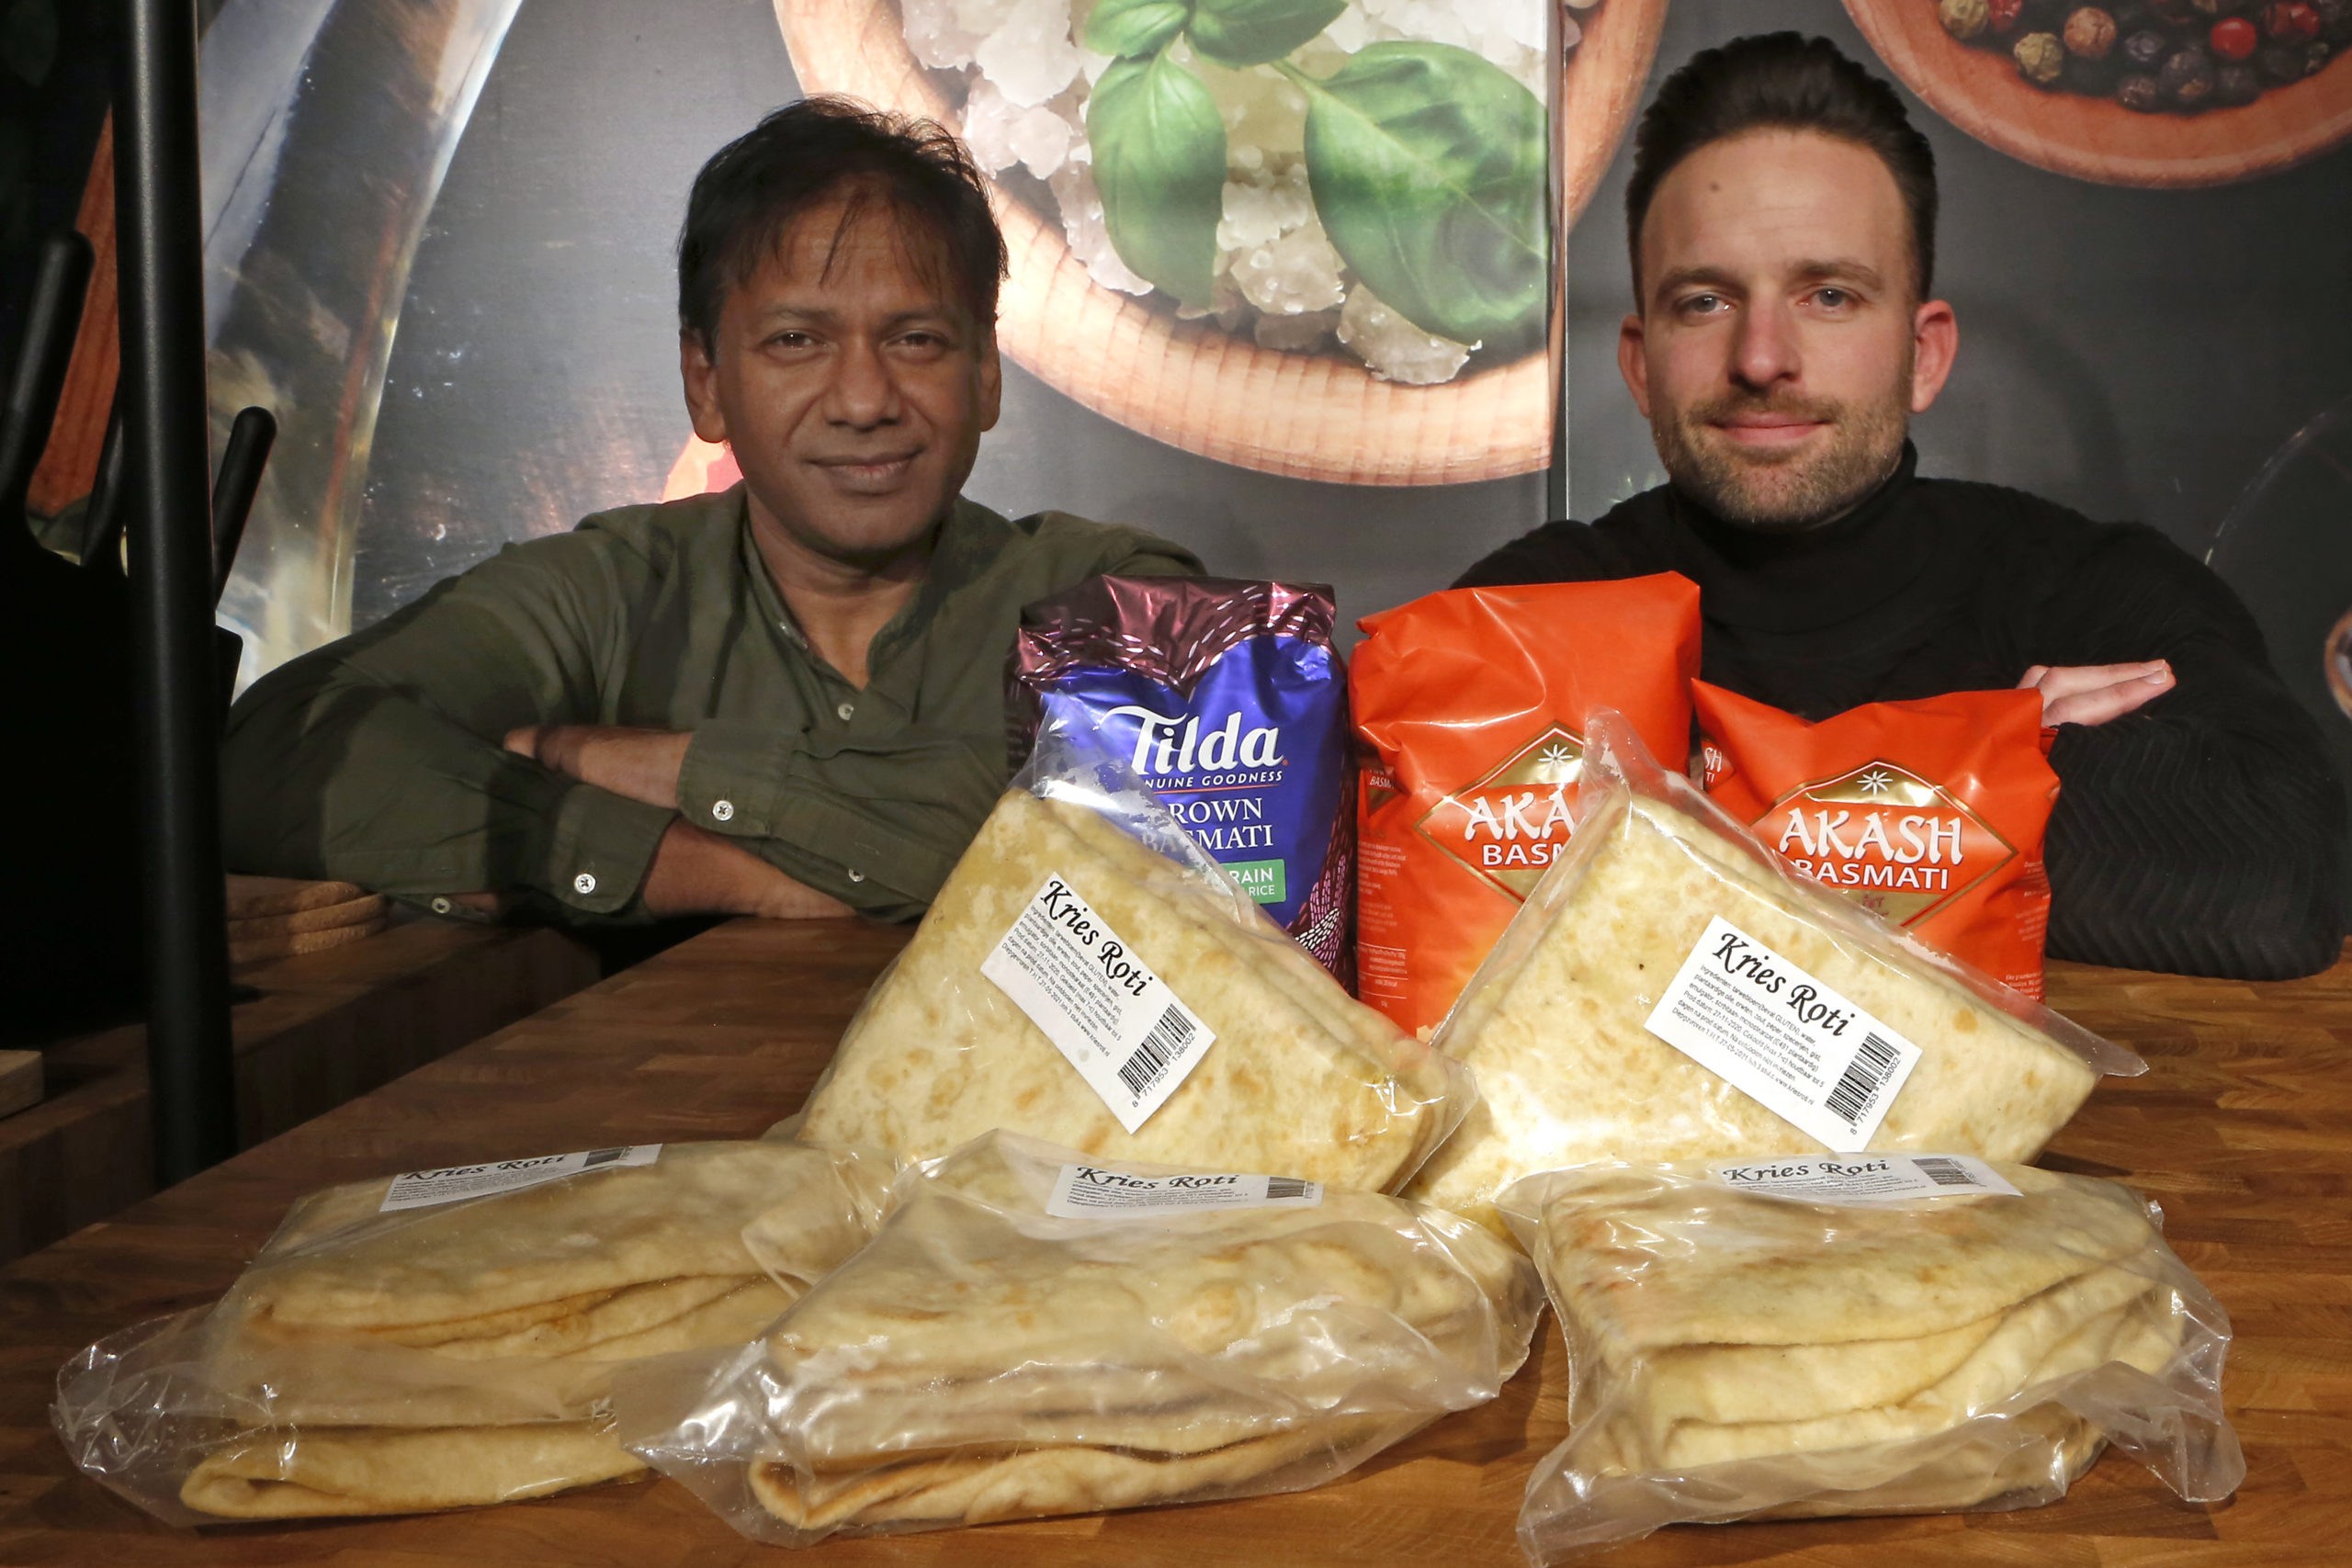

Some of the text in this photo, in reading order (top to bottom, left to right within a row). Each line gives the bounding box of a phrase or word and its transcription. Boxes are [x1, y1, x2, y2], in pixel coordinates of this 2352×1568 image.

[1097, 705, 1284, 775] Tilda
[1145, 771, 1283, 789] NUINE GOODNESS
[1168, 797, 1263, 824] ROWN
[1464, 789, 1577, 840] AKA
[1779, 807, 1964, 865] AKASH
[1228, 867, 1273, 886] RAIN
[1249, 885, 1275, 897] RICE
[1794, 859, 1949, 890] BASMATI
[1040, 880, 1153, 996] Kries Roti
[1712, 933, 1855, 1036] Kries Roti
[1142, 1067, 1168, 1096] 717953
[1170, 1032, 1194, 1061] 138002
[1857, 1092, 1879, 1122] 717953
[1879, 1056, 1901, 1086] 138002
[1077, 1166, 1240, 1190] Kries Roti
[1723, 1159, 1891, 1182] Kries Roti
